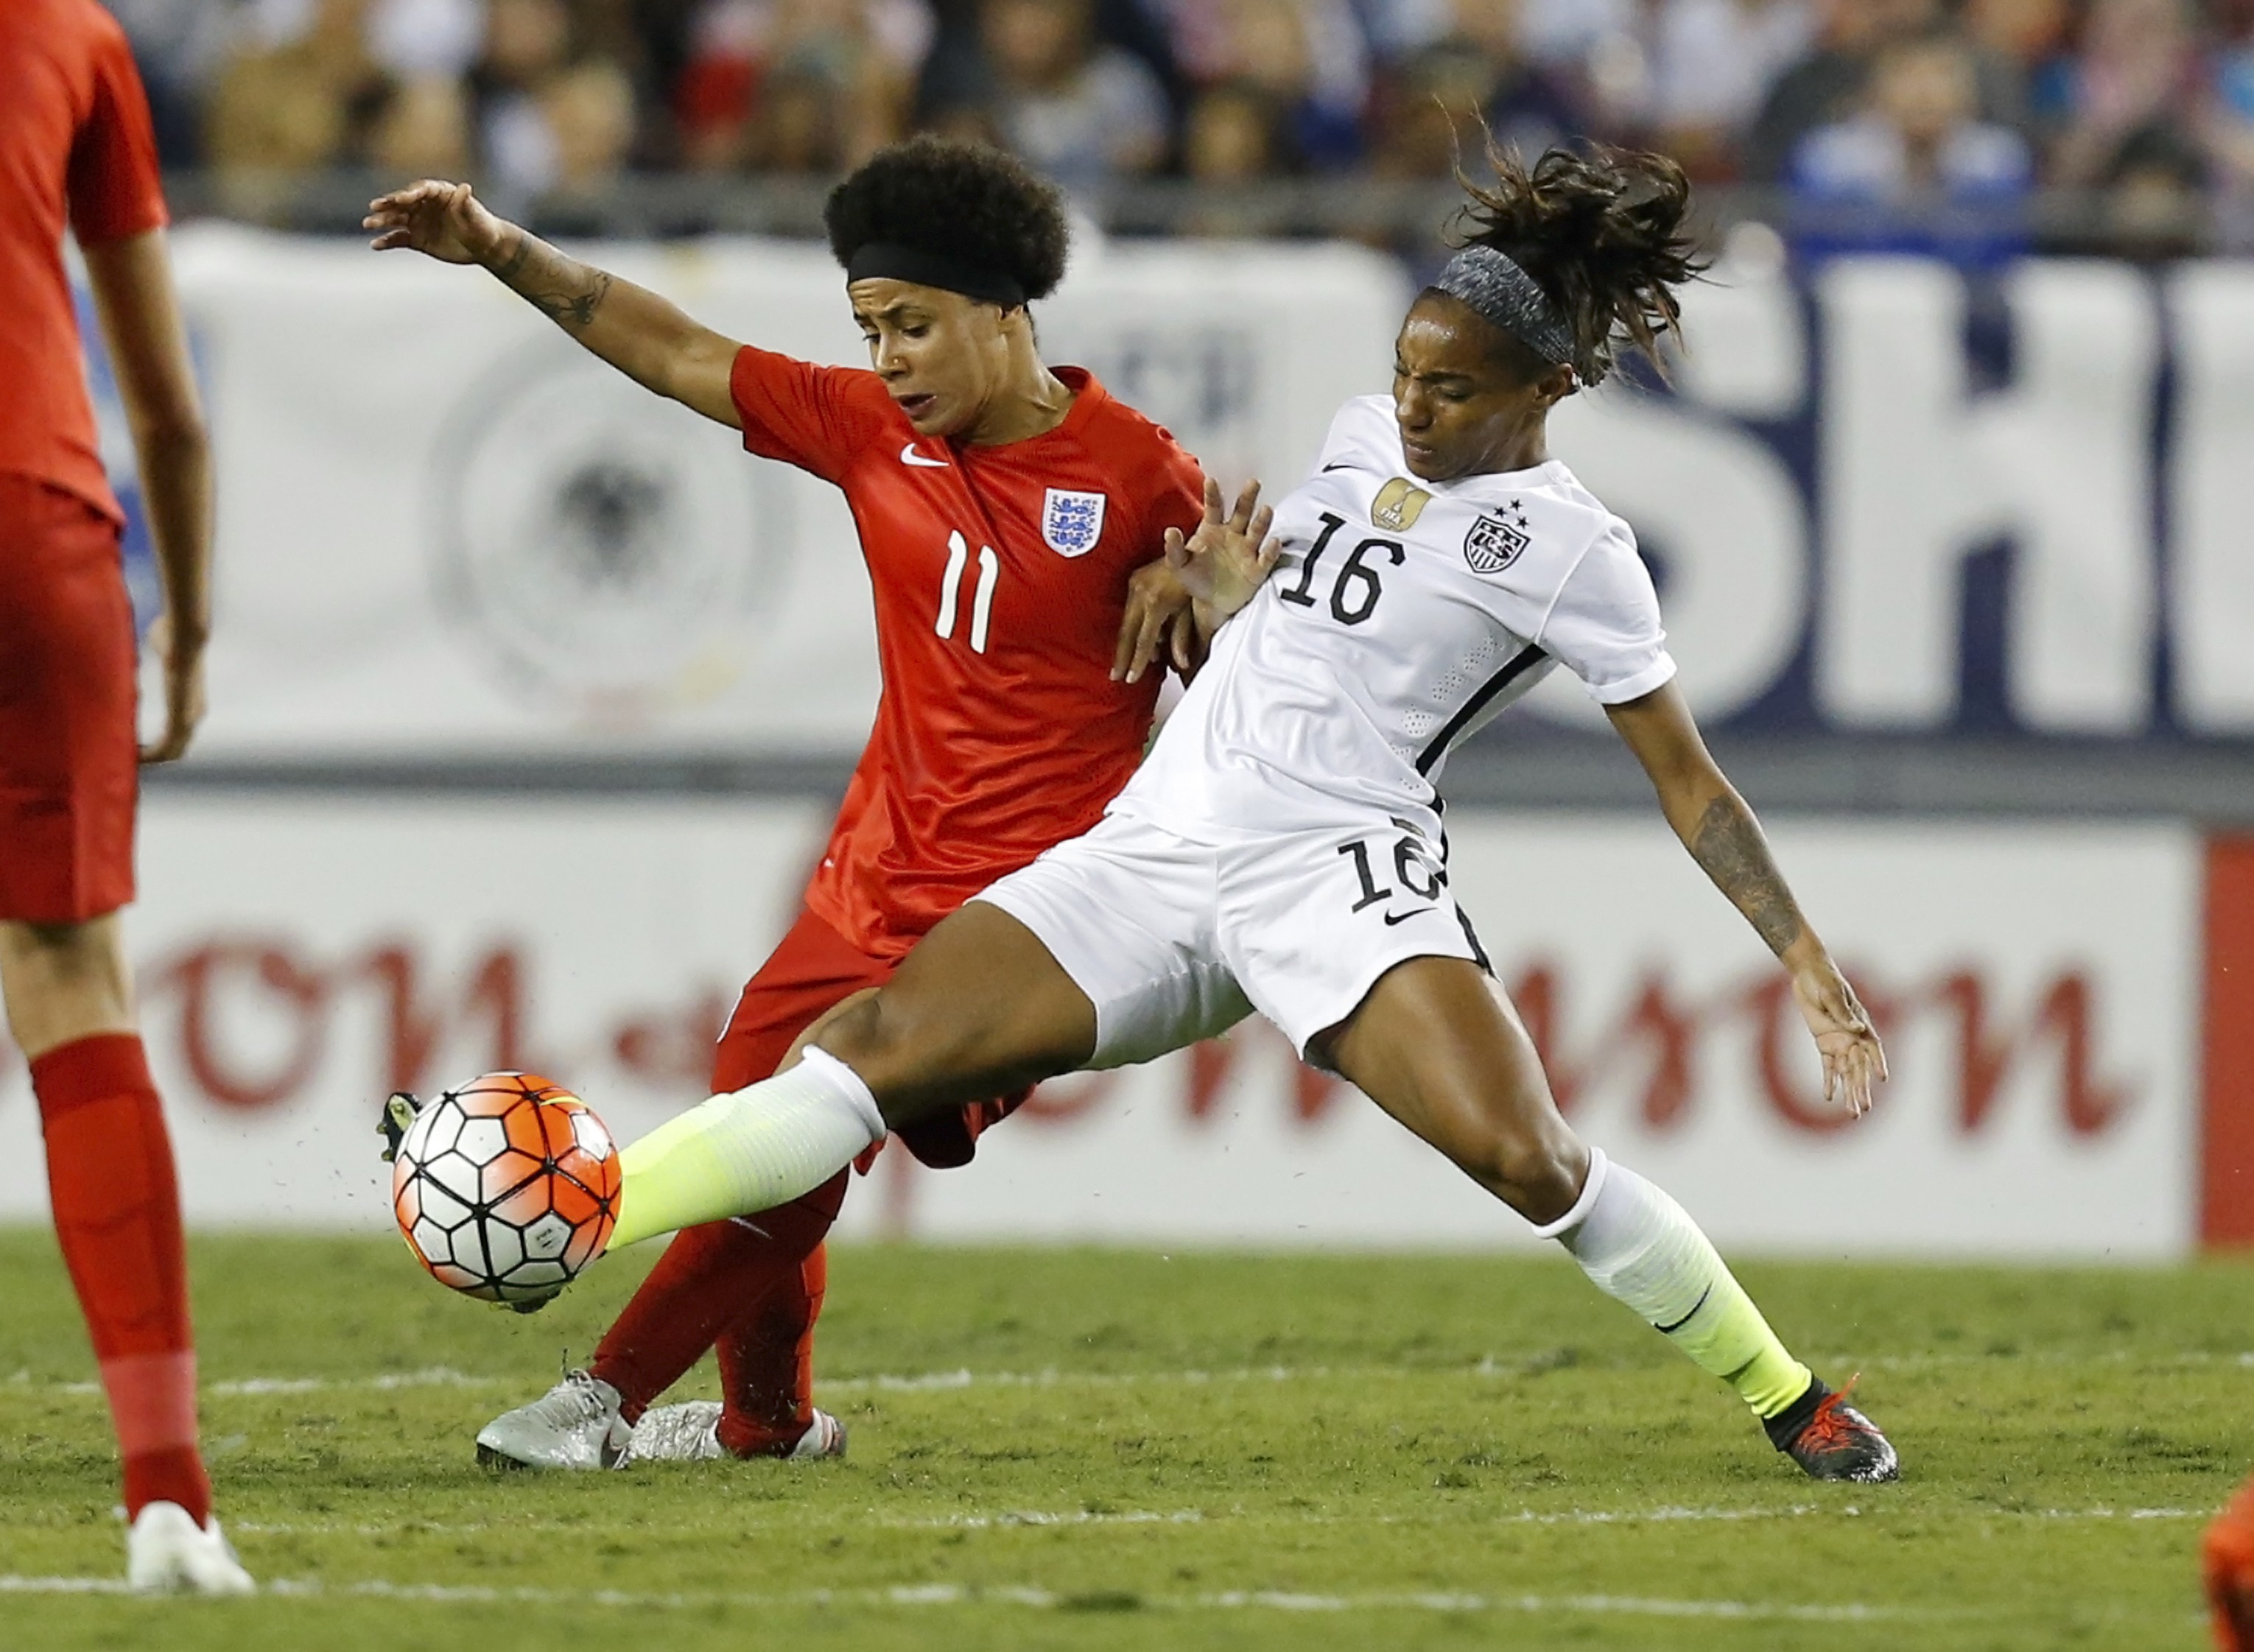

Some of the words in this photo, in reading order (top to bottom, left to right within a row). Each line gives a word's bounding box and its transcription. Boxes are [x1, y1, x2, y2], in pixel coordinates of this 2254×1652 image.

[934, 529, 1000, 655] 11
[1280, 511, 1406, 626] 16
[1337, 835, 1441, 914] 16
